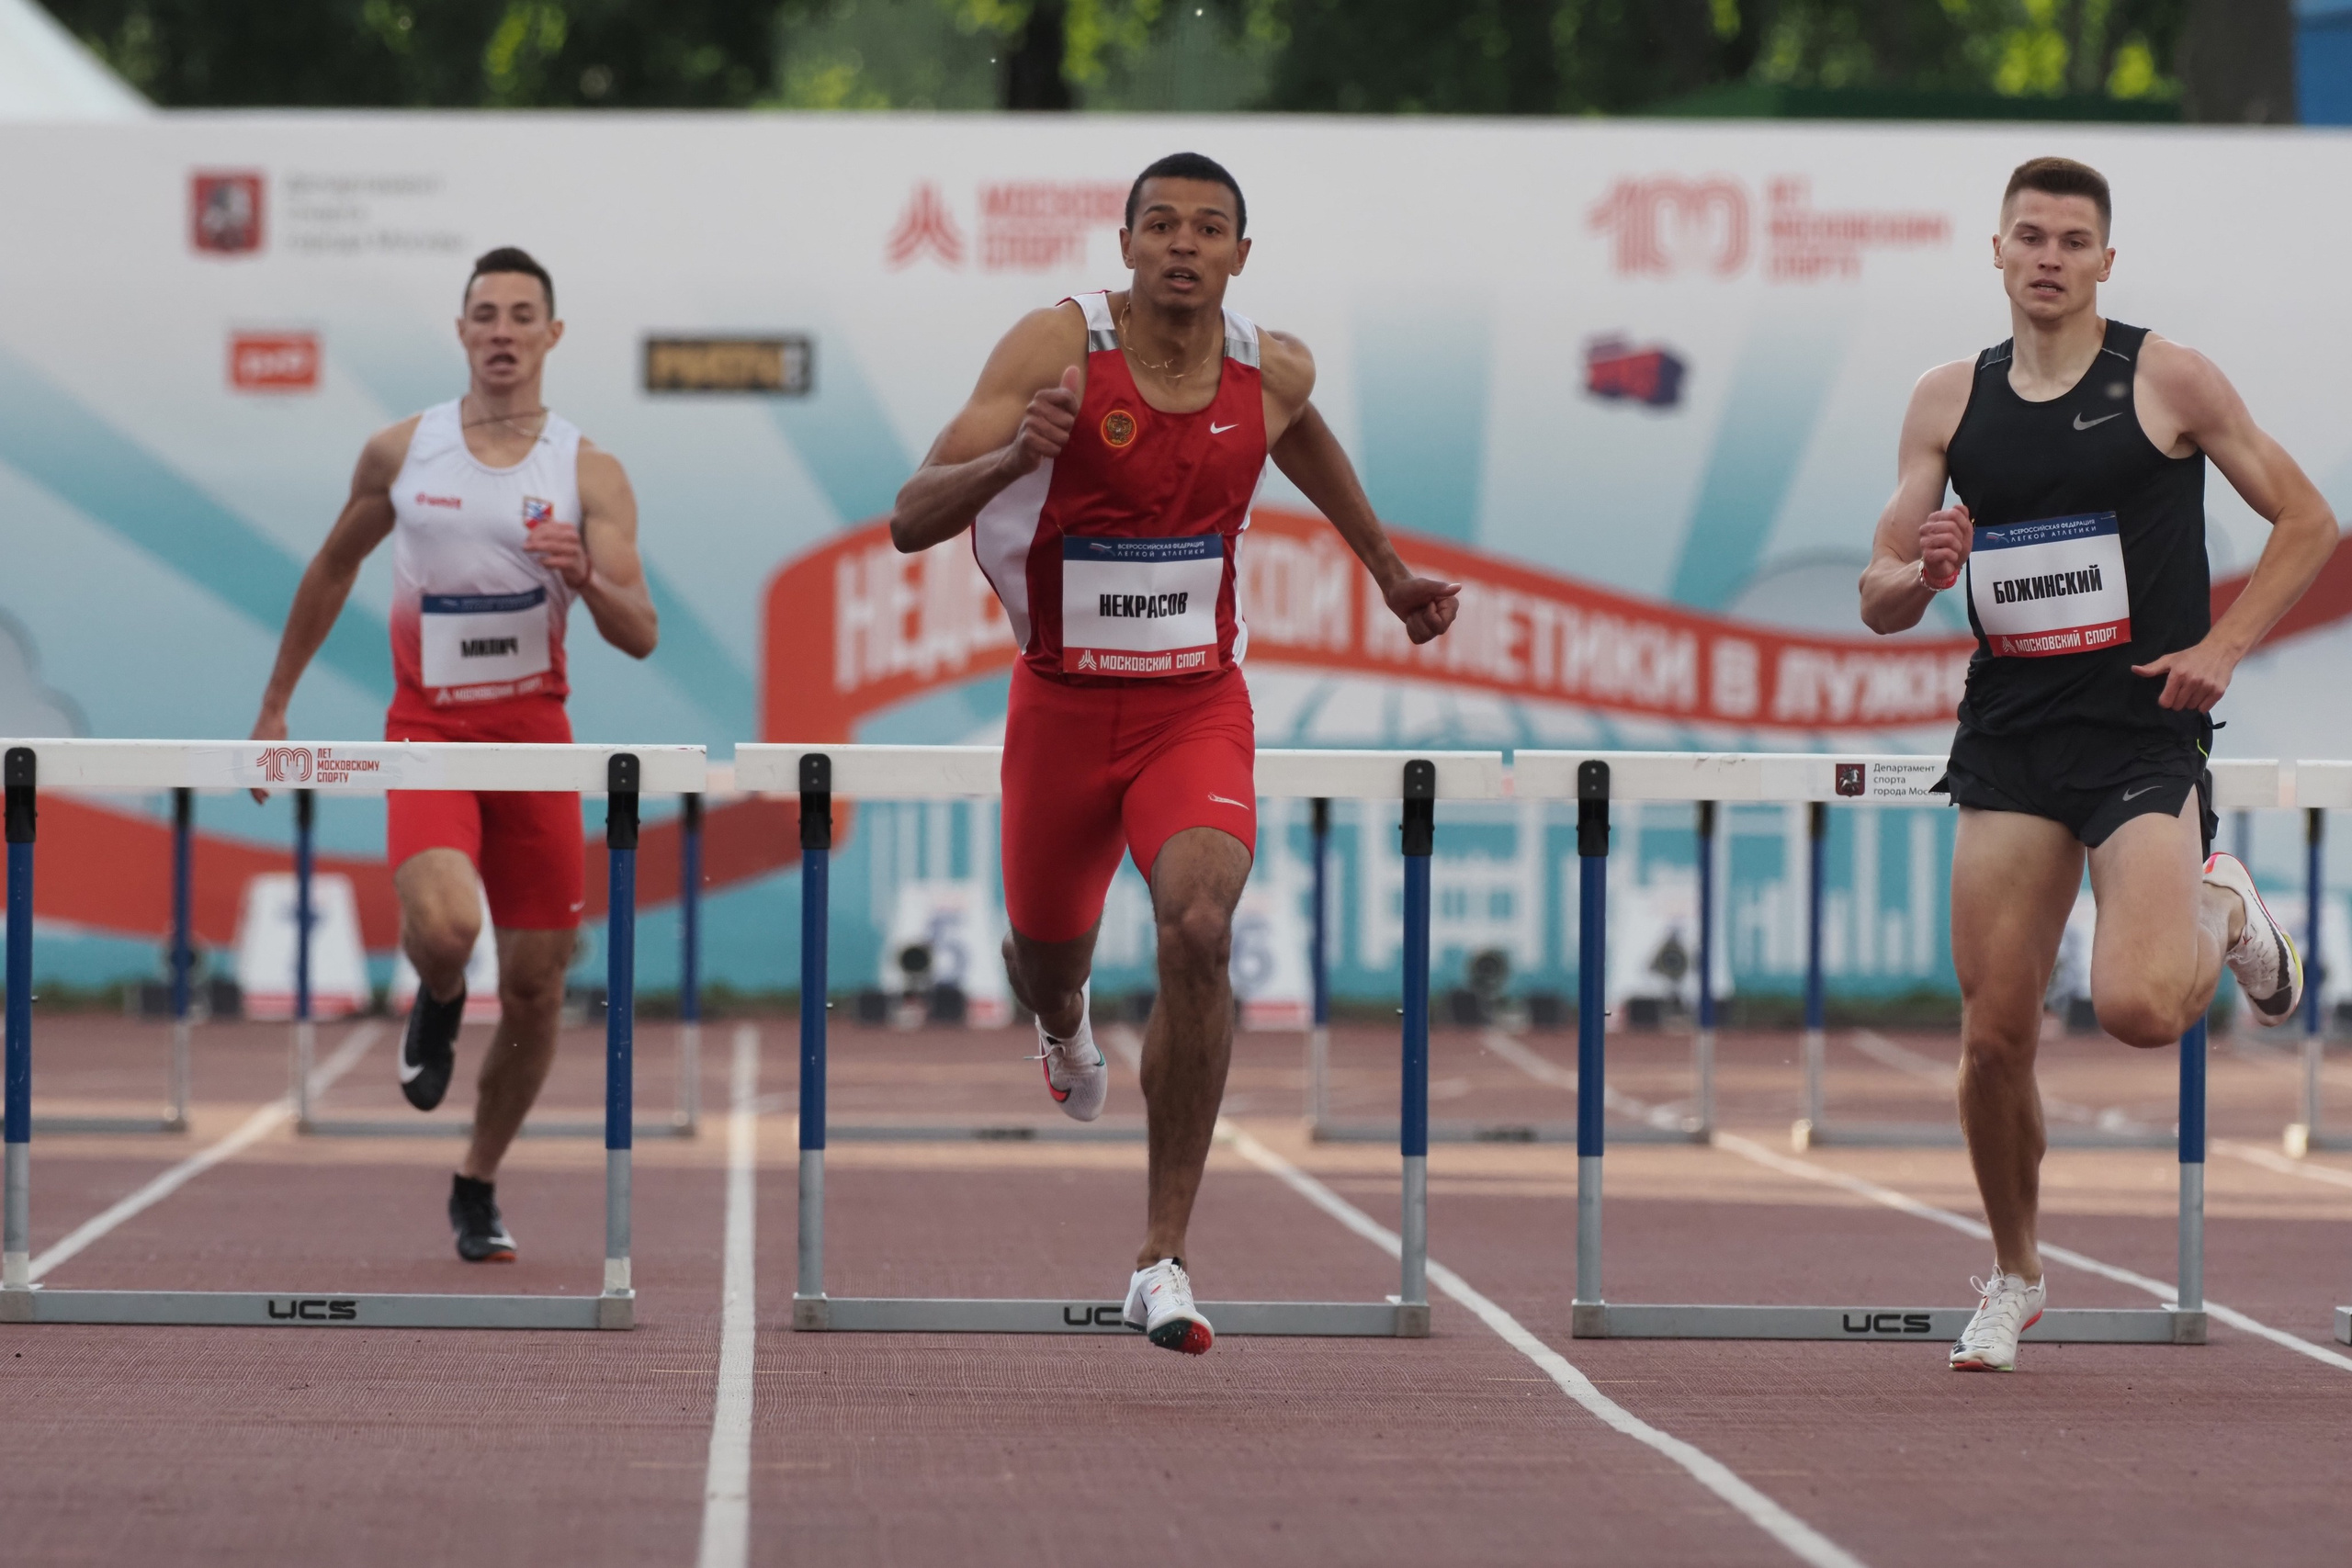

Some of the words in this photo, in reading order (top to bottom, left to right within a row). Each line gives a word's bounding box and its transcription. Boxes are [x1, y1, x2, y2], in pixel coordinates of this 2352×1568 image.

[2009, 524, 2060, 536] ВСЕРОССИЙСКАЯ
[2060, 519, 2096, 529] ФЕДЕРАЦИЯ
[2010, 532, 2046, 543] ЛЕГКОЙ
[2052, 525, 2097, 537] АТЛЕТИКИ
[1161, 548, 1204, 557] АТЛЕТИКИ
[1993, 564, 2103, 604] БОЖИНСКИЙ
[1100, 592, 1189, 618] НЕКРАСОВ
[2015, 630, 2081, 652] МОСКОВСКИЙ
[2085, 626, 2118, 645] СПОРТ
[1100, 652, 1172, 671] МОСКОВСКИЙ
[1176, 651, 1205, 669] СПОРТ
[317, 748, 332, 759] ЛЕТ
[256, 748, 312, 782] 100
[317, 761, 379, 771] МОСКОВСКОМУ
[1873, 763, 1935, 773] Департамент
[317, 773, 349, 783] СПОРТУ
[1873, 775, 1905, 784] спорта
[1873, 787, 1906, 796] города
[268, 1300, 357, 1320] UCS
[1063, 1306, 1125, 1325] UC
[1843, 1314, 1931, 1333] UCS
